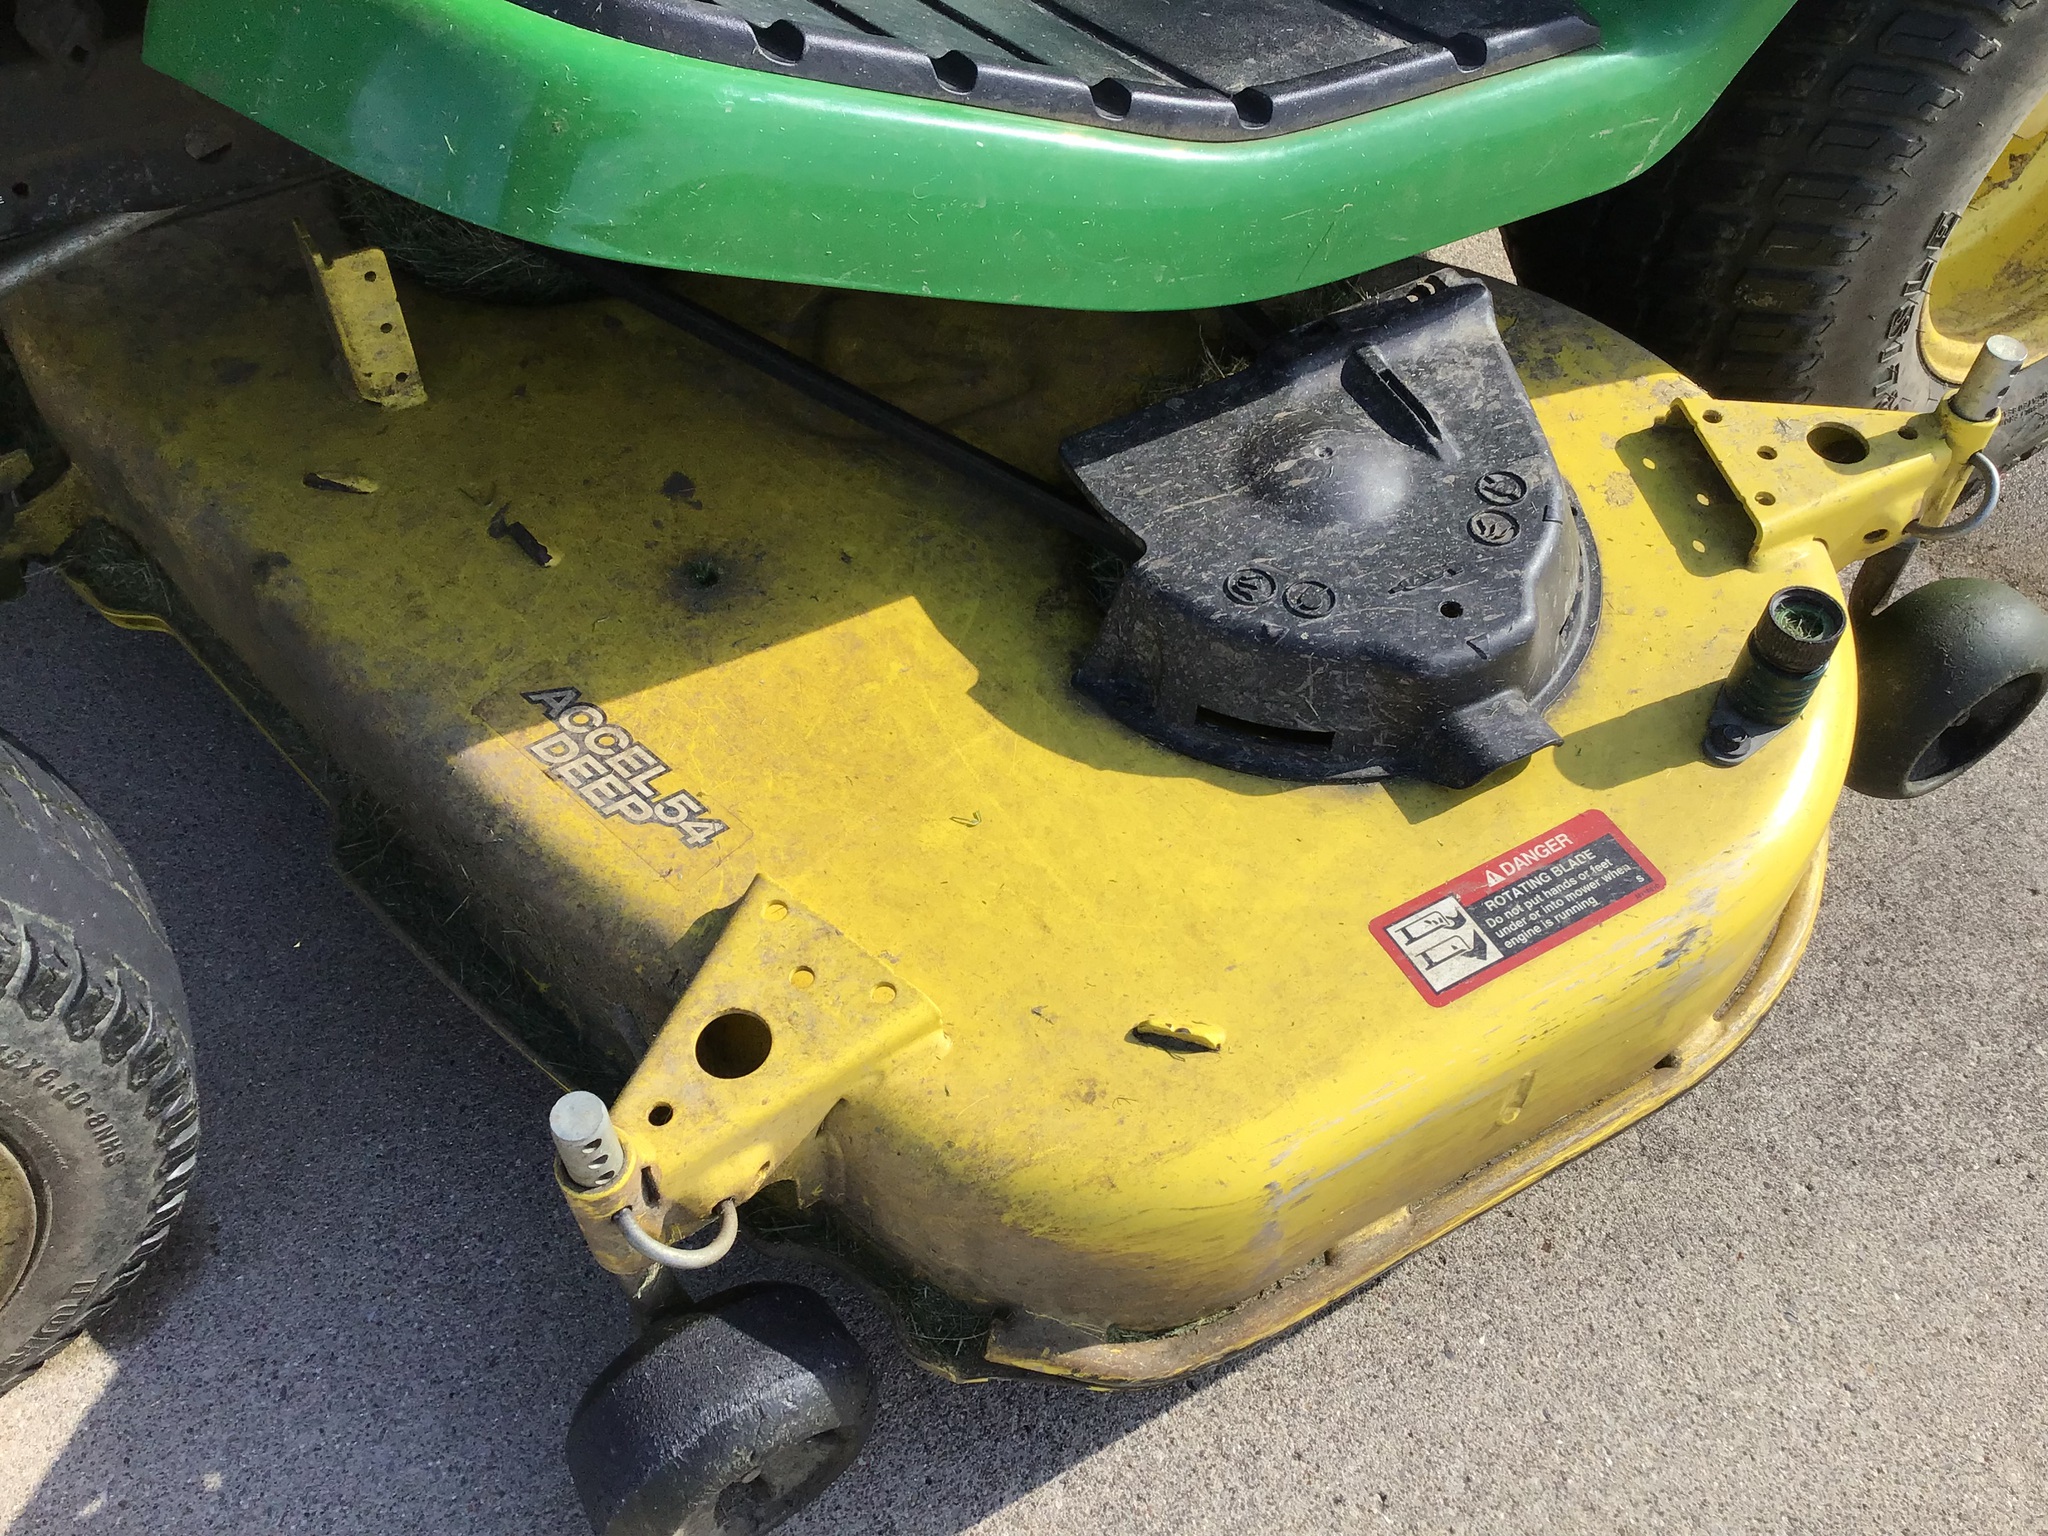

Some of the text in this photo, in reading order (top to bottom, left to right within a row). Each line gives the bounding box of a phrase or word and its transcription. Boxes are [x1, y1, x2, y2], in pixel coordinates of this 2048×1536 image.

[520, 686, 730, 849] ACCEL 54
[524, 731, 655, 824] DEEP
[1484, 849, 1596, 911] ROTATING BLADE
[1499, 833, 1573, 876] DANGER
[1485, 858, 1614, 929] Do not put hands or feet
[1495, 864, 1633, 939] under or into mower when
[1504, 896, 1599, 950] engine is running
